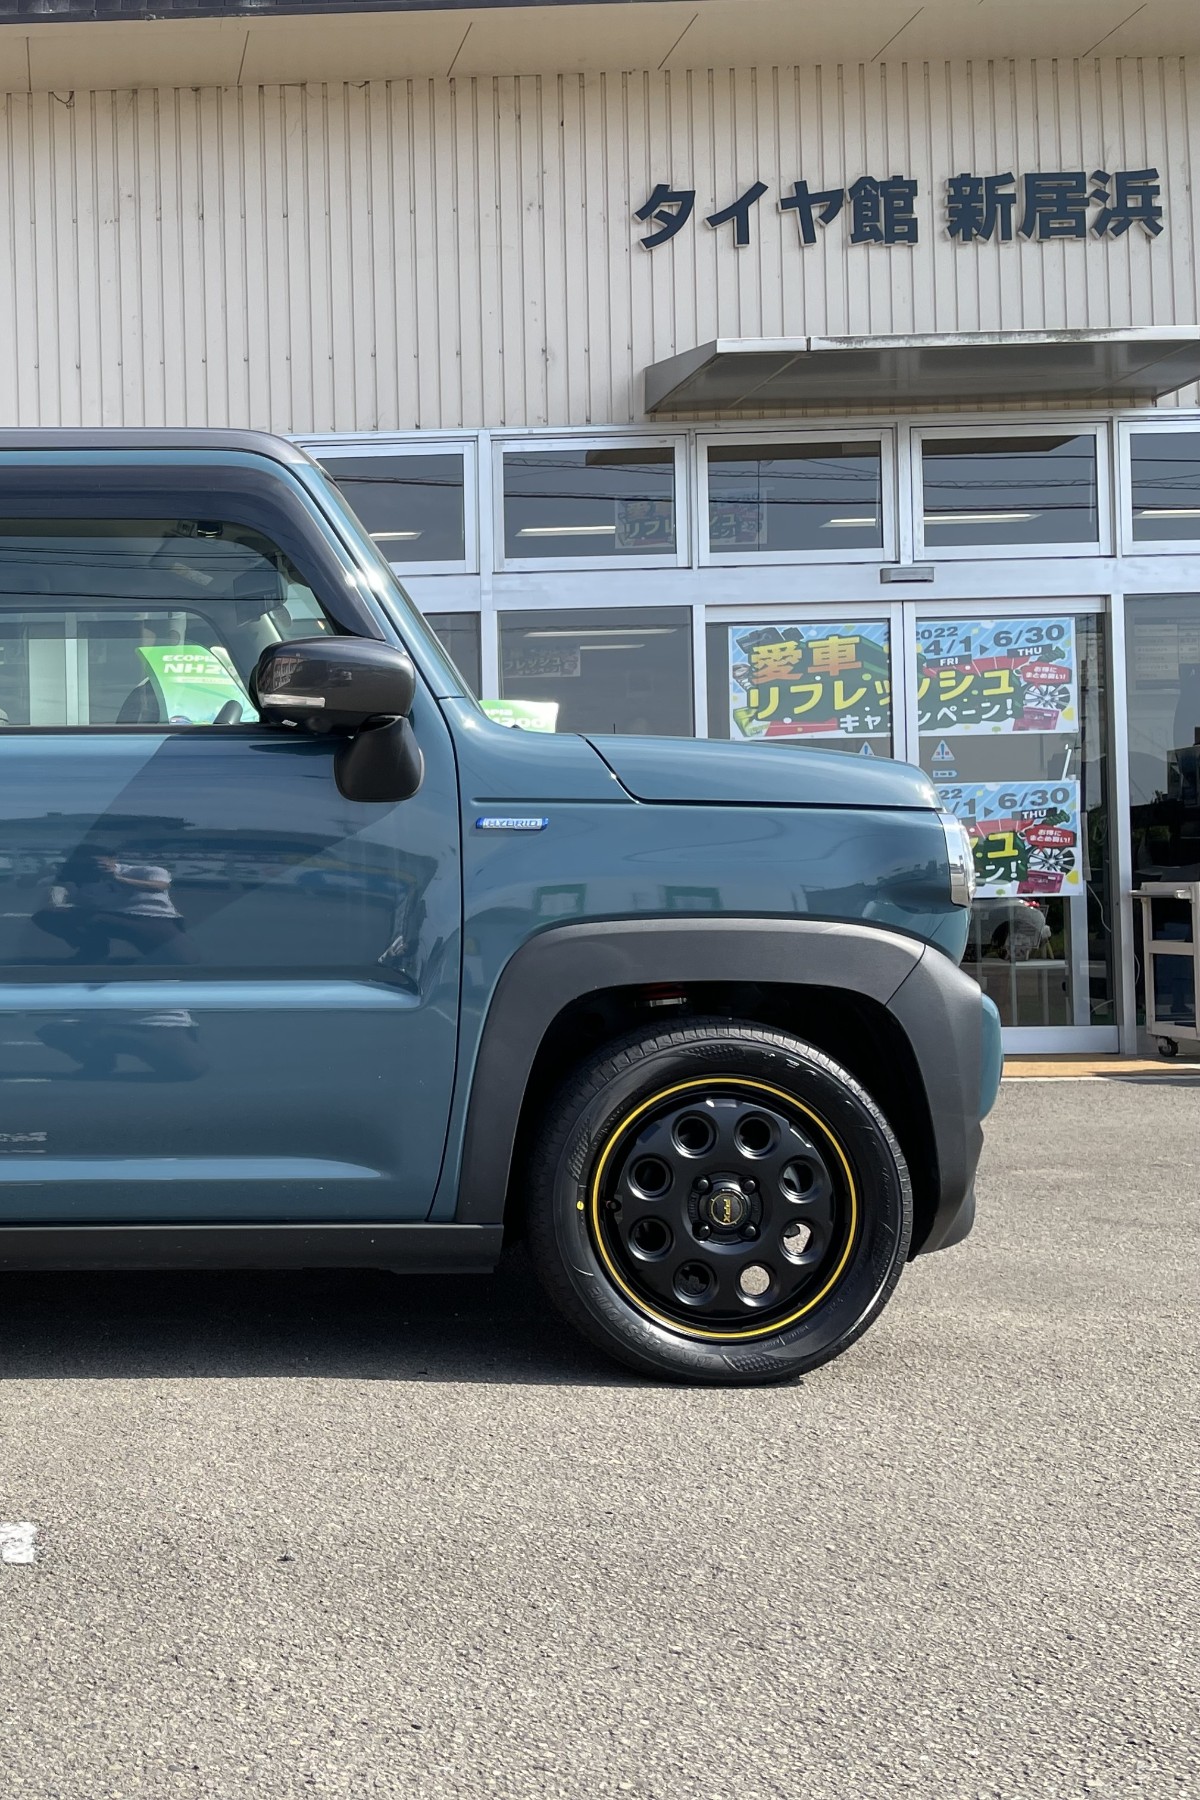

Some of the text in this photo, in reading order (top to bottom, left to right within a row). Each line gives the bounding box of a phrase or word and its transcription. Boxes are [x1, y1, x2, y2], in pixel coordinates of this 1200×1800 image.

[633, 167, 1163, 251] タイヤ館 新居浜
[924, 624, 1065, 656] 4/1 6/30
[751, 634, 862, 684] 愛車
[939, 646, 1042, 667] FRI THU
[998, 787, 1070, 810] 6/30
[1021, 809, 1047, 820] THU
